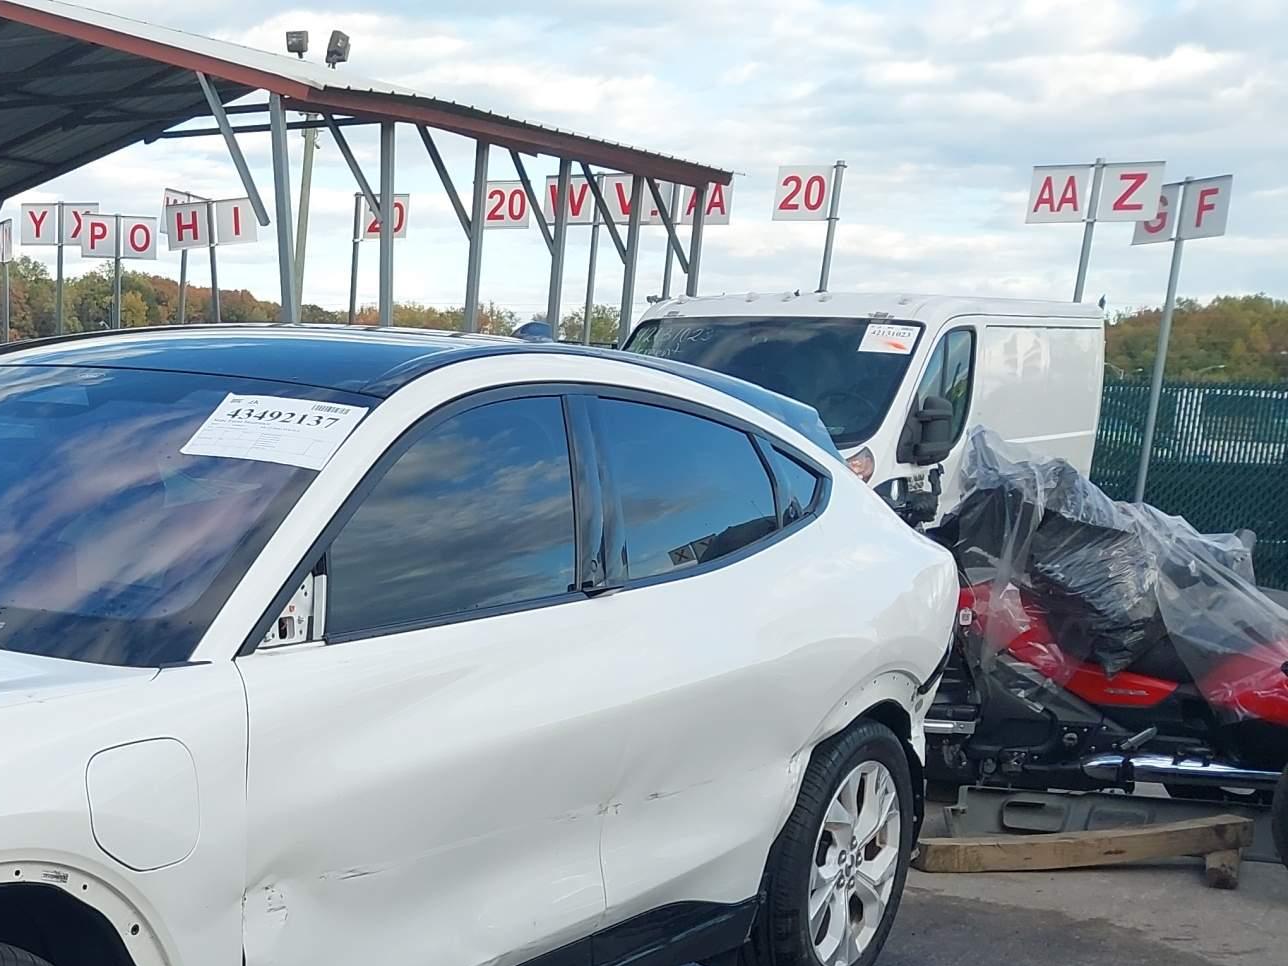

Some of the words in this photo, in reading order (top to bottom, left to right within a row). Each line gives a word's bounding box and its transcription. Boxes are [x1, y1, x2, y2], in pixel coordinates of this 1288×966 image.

[487, 189, 526, 221] 20
[550, 184, 588, 216] W
[778, 175, 826, 210] 20
[1032, 175, 1079, 212] AA
[1112, 173, 1148, 211] Z
[1195, 188, 1219, 227] F
[28, 210, 48, 238] Y
[91, 222, 107, 250] P
[176, 211, 198, 241] H
[233, 206, 240, 236] I
[129, 224, 150, 252] O
[227, 408, 340, 429] 43492137
